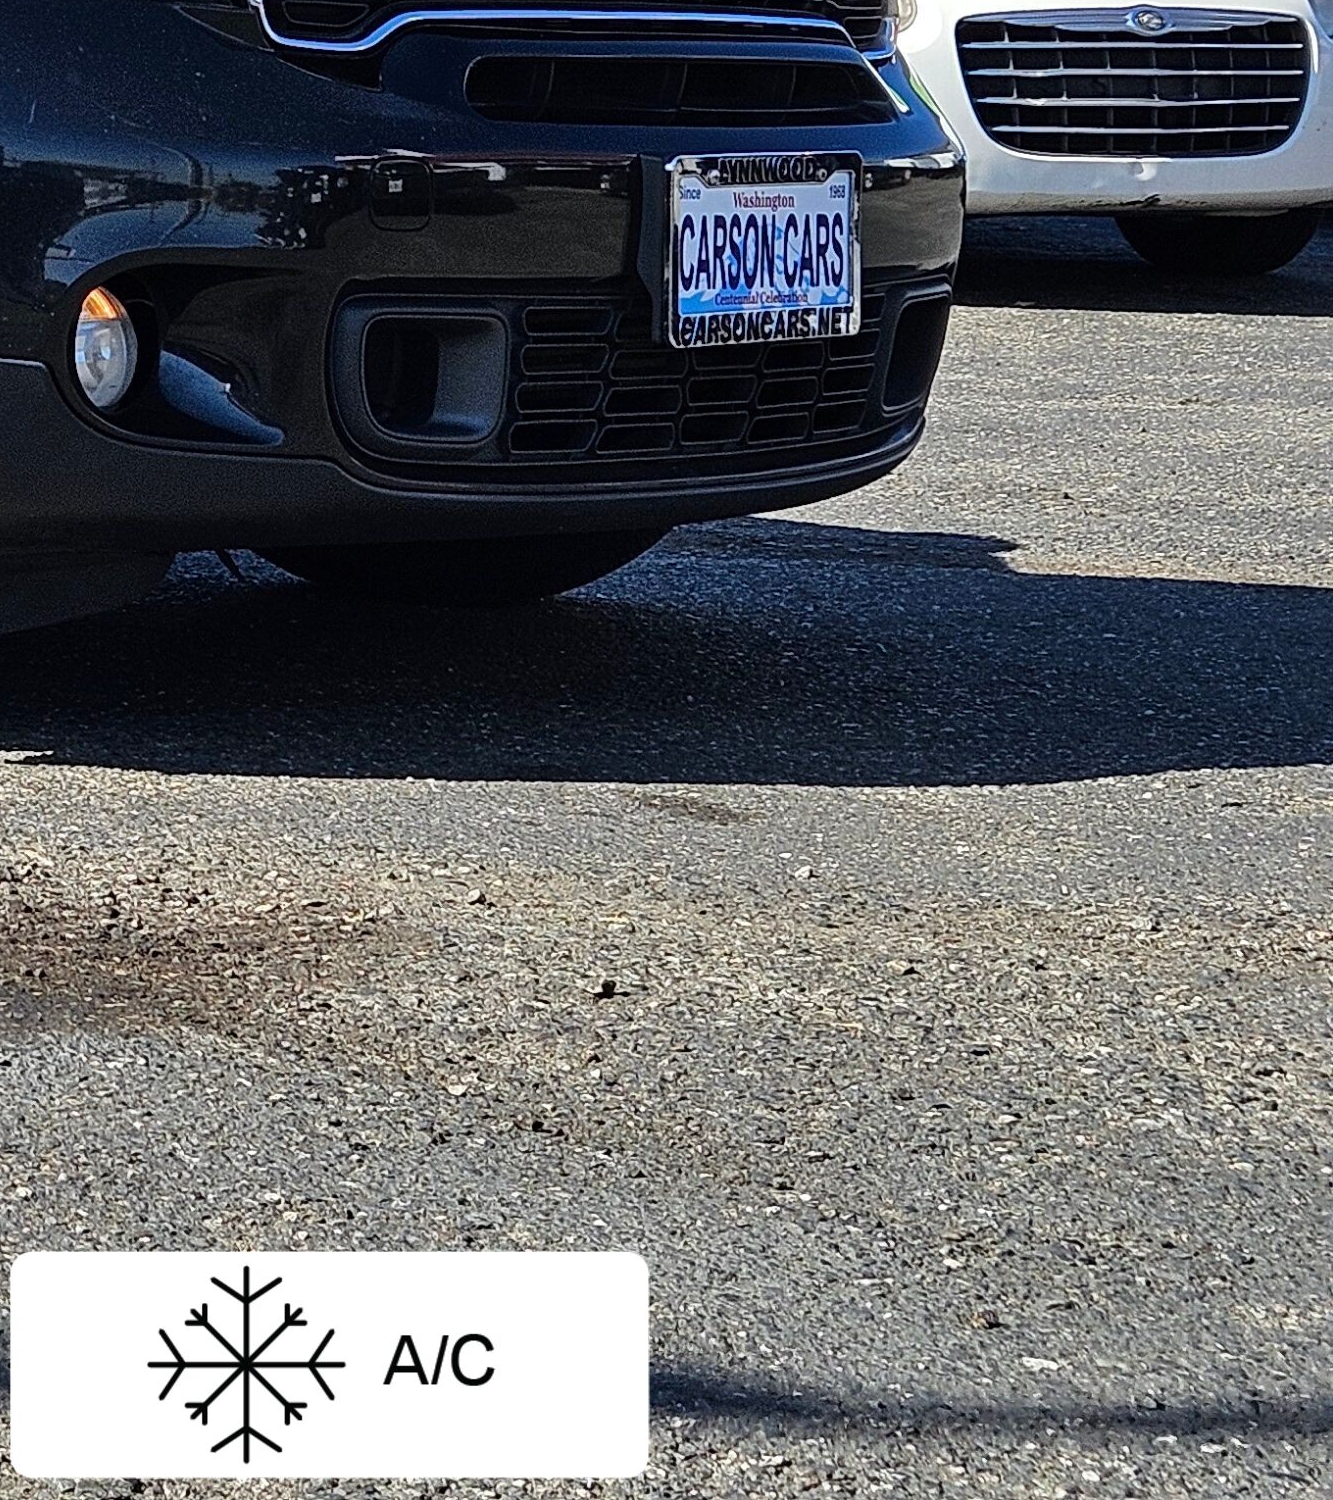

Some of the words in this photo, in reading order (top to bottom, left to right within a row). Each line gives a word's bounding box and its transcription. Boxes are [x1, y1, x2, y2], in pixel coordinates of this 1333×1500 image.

[680, 186, 702, 201] Since
[733, 191, 796, 212] Washington
[679, 212, 776, 292] CARSON
[782, 212, 845, 288] CARS
[714, 293, 759, 306] Centennial
[680, 306, 854, 347] CARSONCARS.NET
